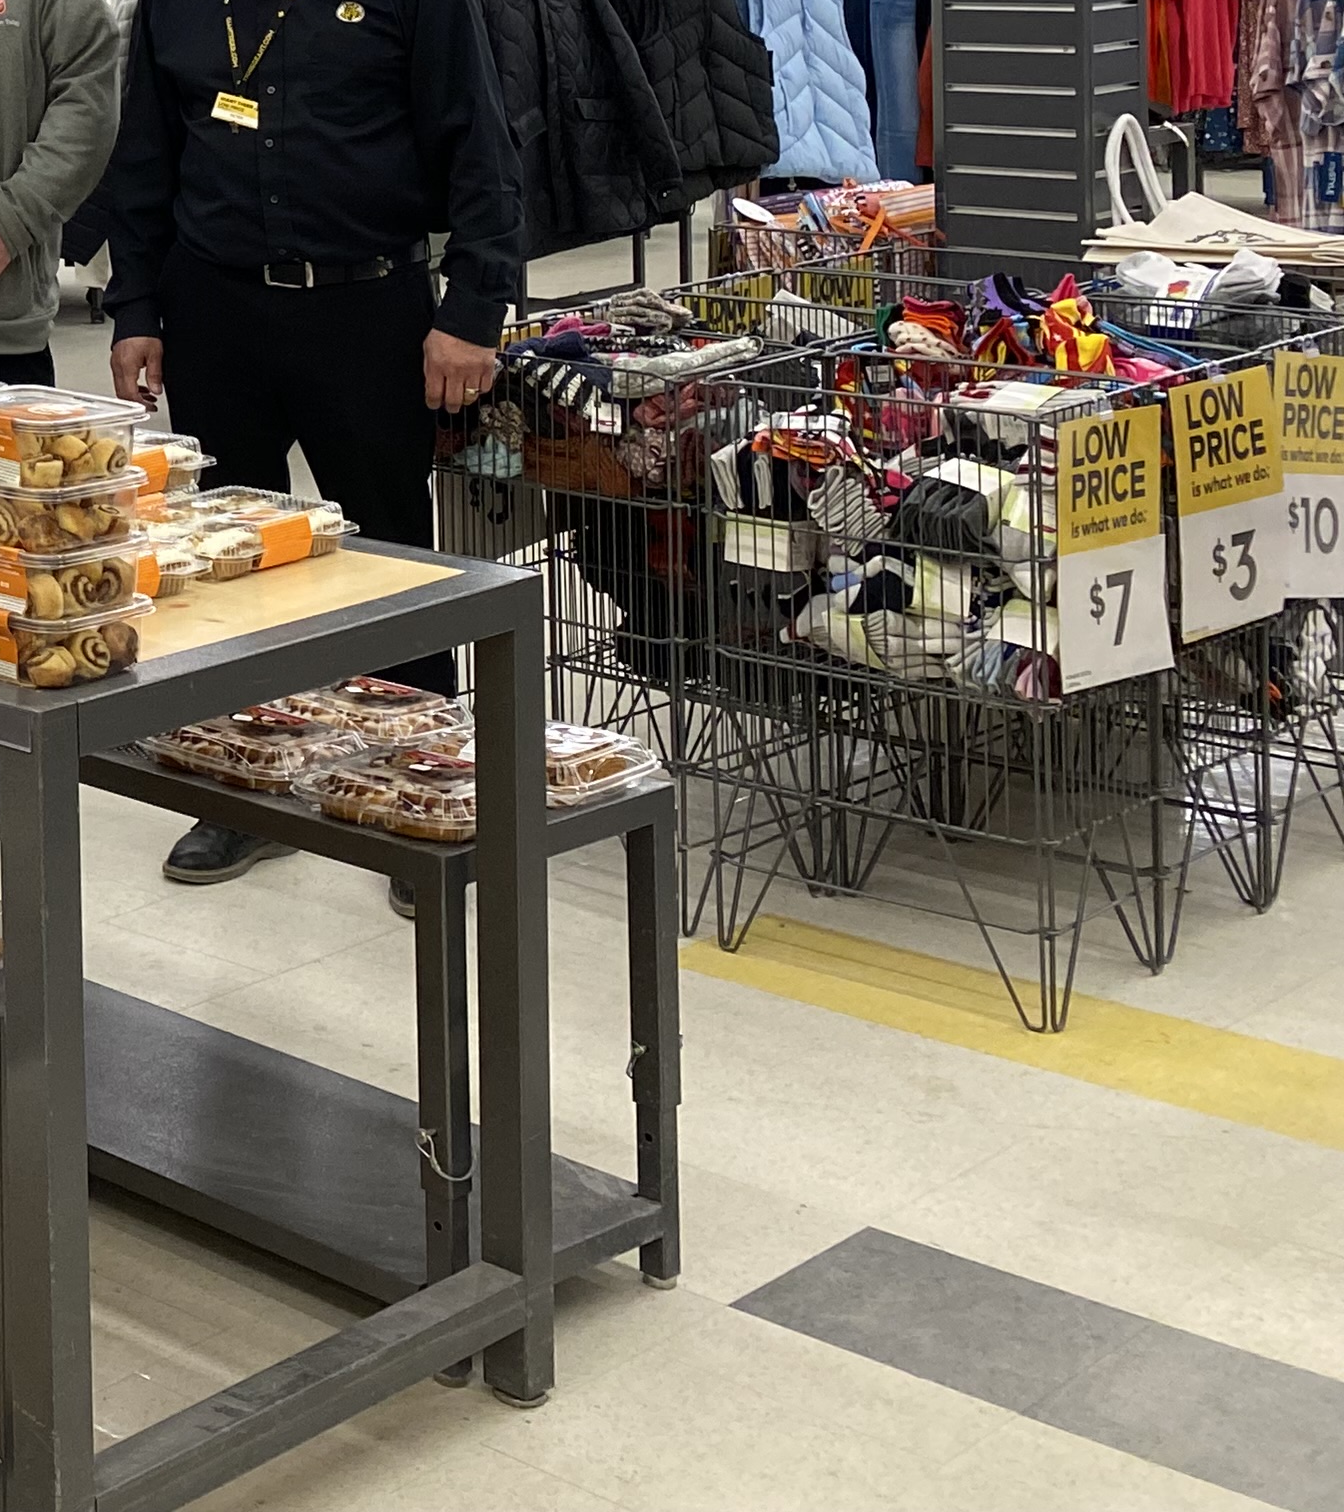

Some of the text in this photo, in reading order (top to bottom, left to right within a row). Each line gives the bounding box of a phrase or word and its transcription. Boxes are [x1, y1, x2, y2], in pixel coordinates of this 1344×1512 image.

[1285, 363, 1337, 399] LOW
[1185, 381, 1244, 430] LOW
[1282, 403, 1344, 440] PRICE
[1072, 420, 1130, 468] LOW
[1189, 419, 1266, 473] PRICE
[1281, 447, 1289, 461] is
[1290, 448, 1314, 462] what
[1315, 451, 1329, 462] we
[1071, 460, 1145, 512] PRICE
[1192, 482, 1202, 497] is
[1204, 475, 1232, 494] what
[1234, 472, 1251, 486] we
[1071, 521, 1080, 538] is
[1082, 517, 1110, 536] what
[1112, 515, 1129, 528] we
[1288, 497, 1339, 554] $10
[1212, 529, 1257, 601] $3
[1090, 569, 1134, 646] $7
